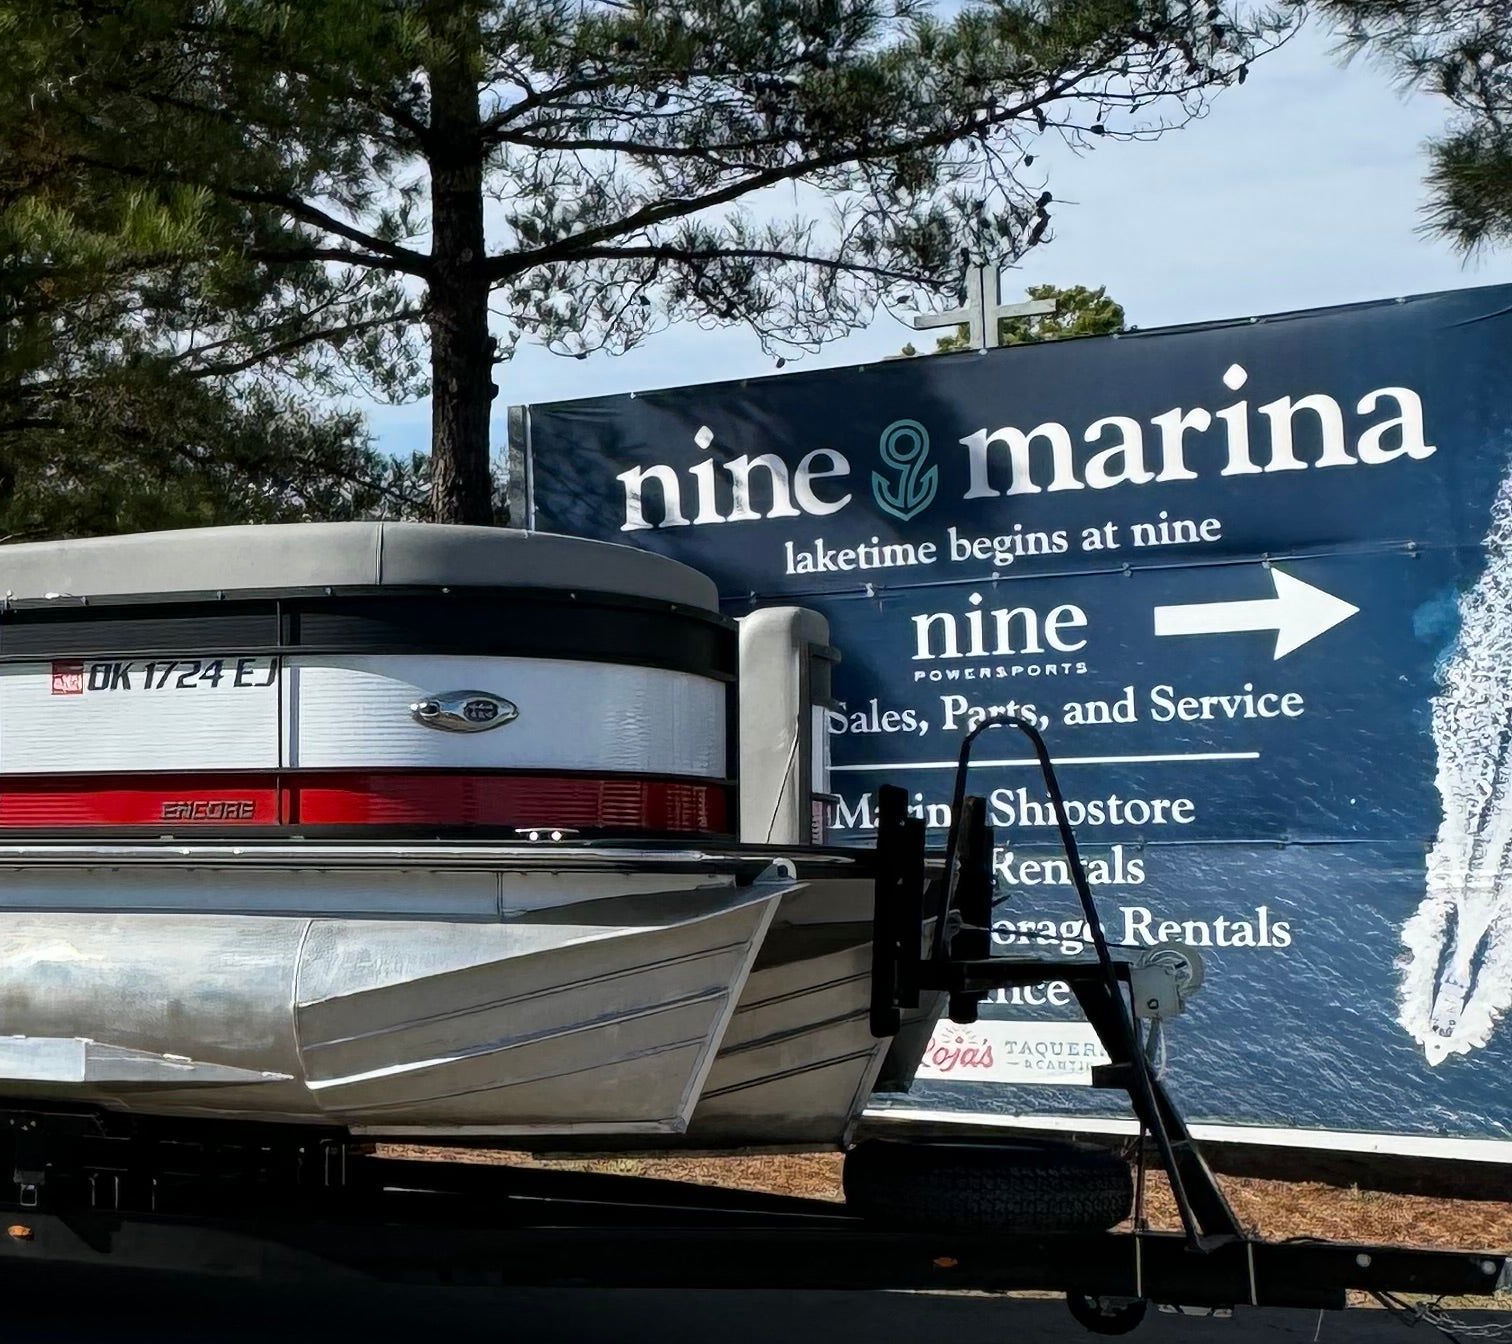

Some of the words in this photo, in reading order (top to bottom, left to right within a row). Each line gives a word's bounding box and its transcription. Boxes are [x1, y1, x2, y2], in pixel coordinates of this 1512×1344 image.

[615, 425, 853, 532] nine
[958, 363, 1437, 500] marina
[784, 535, 937, 575] laketime
[947, 524, 1069, 566] begins
[1081, 521, 1120, 551] at
[1130, 511, 1223, 547] nine
[911, 592, 1088, 660] nine
[88, 662, 133, 691] OK
[144, 659, 225, 690] 1724
[233, 658, 278, 688] EJ
[914, 661, 1088, 682] POWERSPORTS
[827, 698, 929, 737] Sales,
[939, 694, 1050, 733] Parts,
[1063, 685, 1138, 725] and
[1150, 682, 1305, 722] Service
[991, 844, 1146, 886] Renals
[991, 919, 1106, 956] orage
[1119, 905, 1293, 949] Rentals
